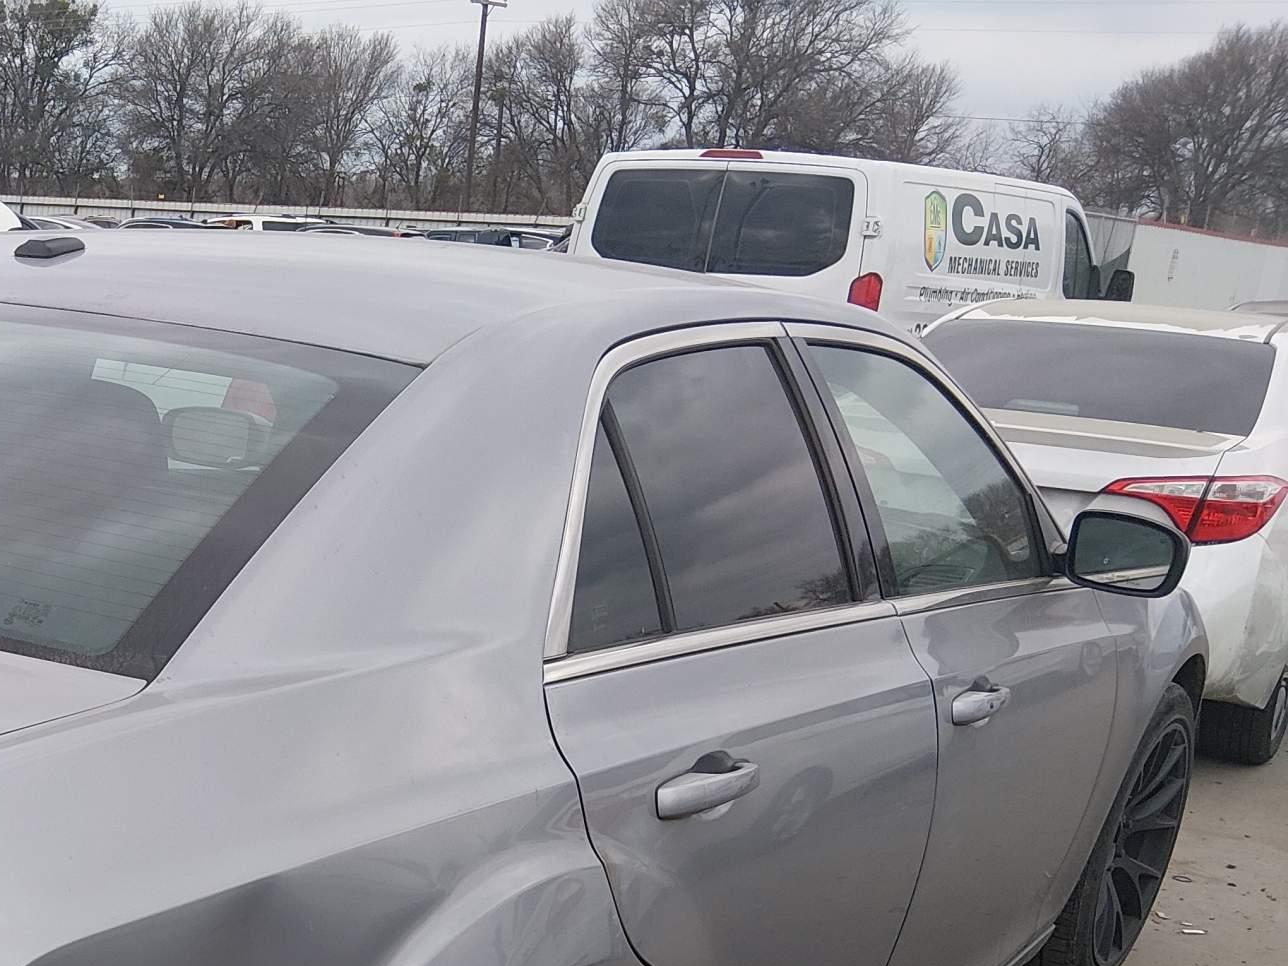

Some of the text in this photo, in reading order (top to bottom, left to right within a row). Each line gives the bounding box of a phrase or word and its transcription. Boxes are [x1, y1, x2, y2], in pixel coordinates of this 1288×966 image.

[952, 193, 1040, 251] CASA
[947, 256, 1040, 279] MECHANICAL SERVICES
[919, 286, 953, 307] Plumbing
